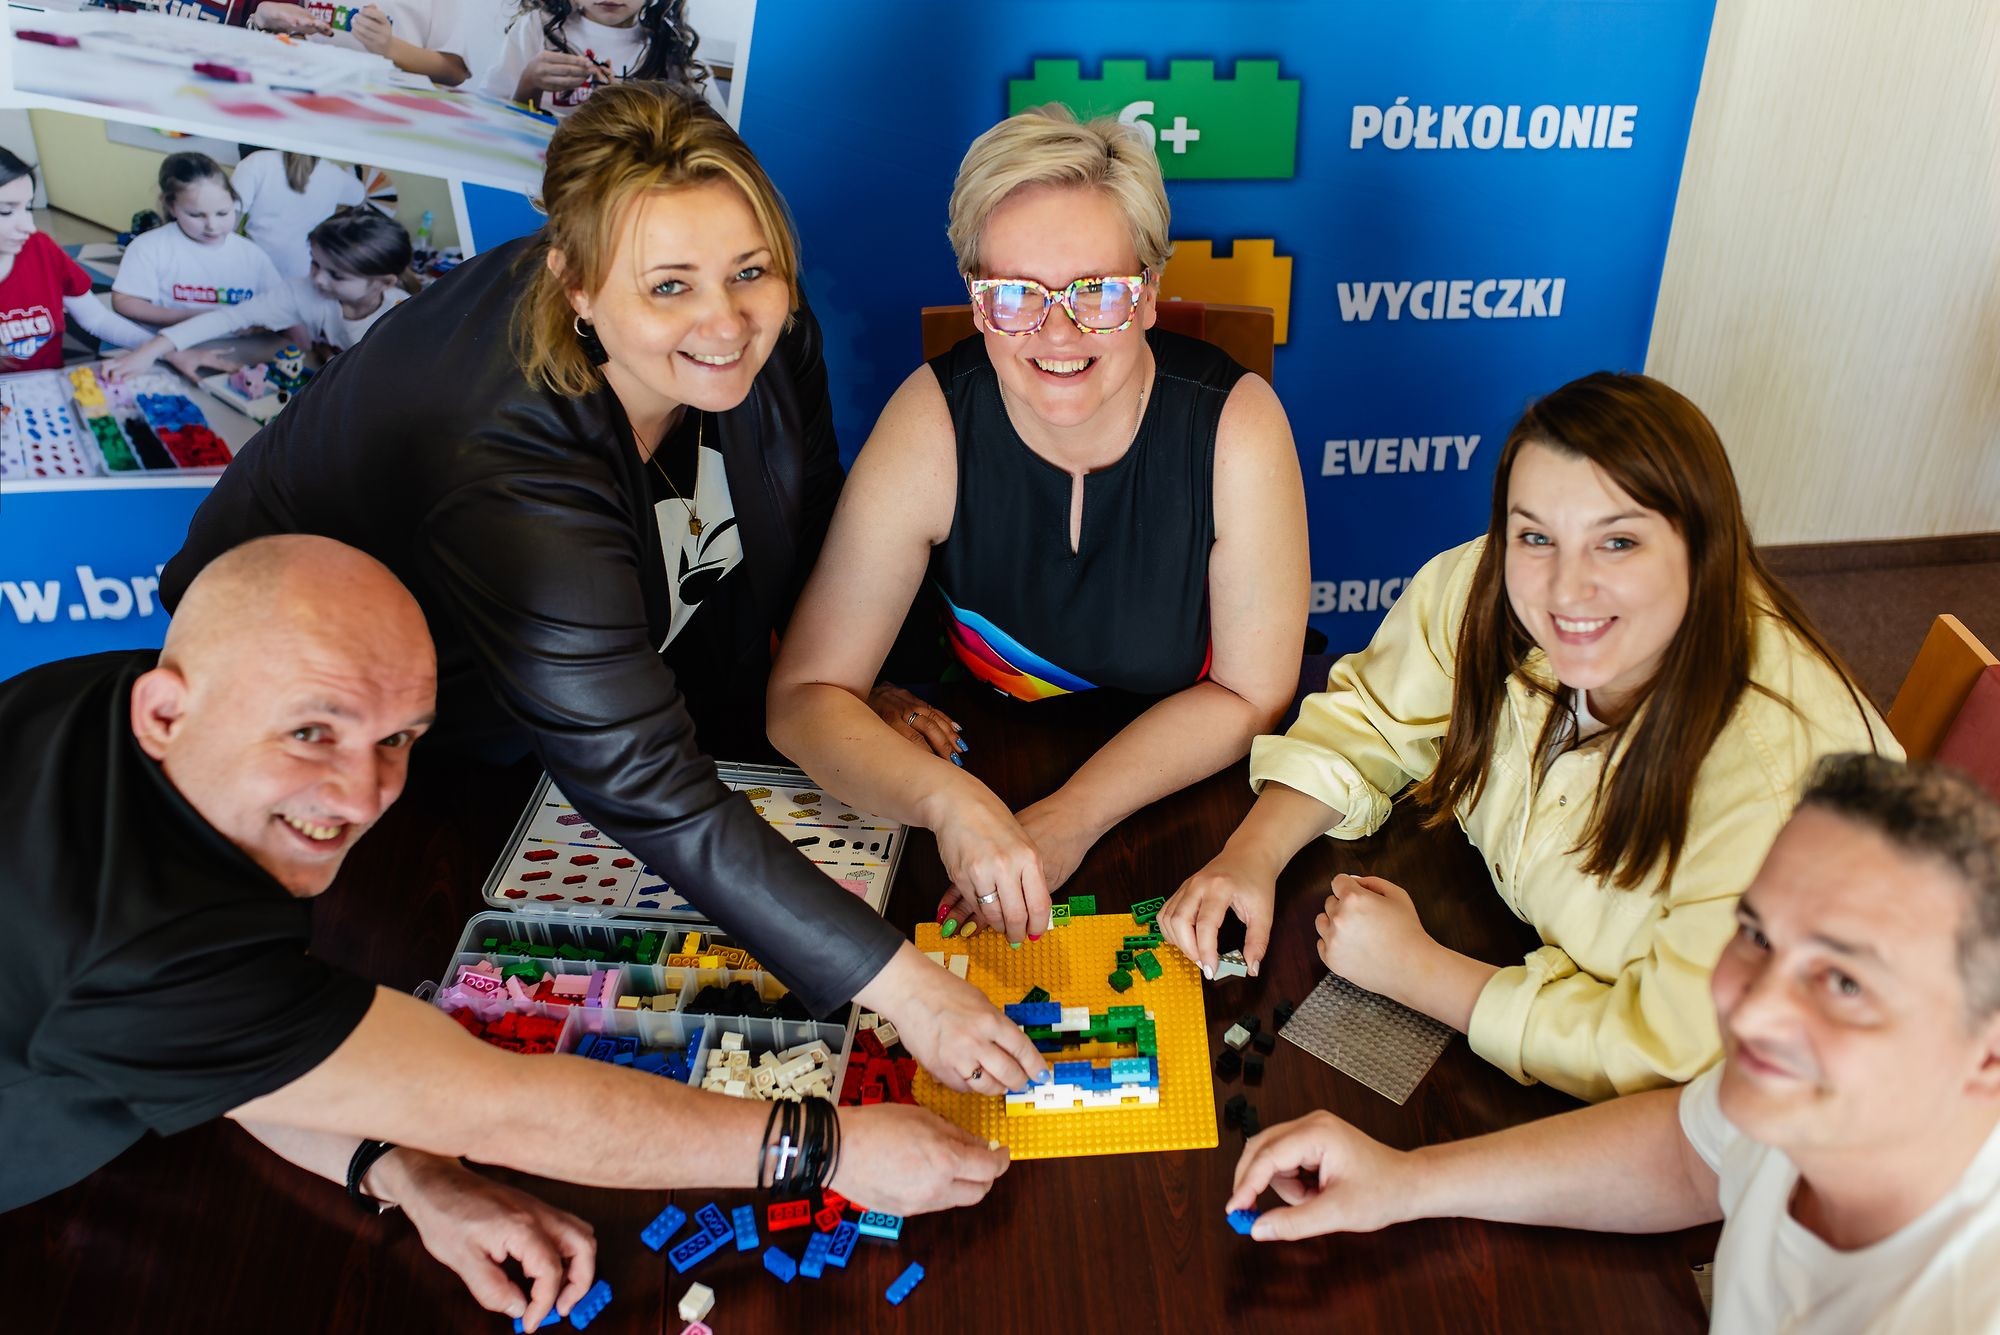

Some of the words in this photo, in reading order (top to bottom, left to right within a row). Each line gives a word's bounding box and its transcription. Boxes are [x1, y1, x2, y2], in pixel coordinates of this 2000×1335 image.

[1118, 100, 1200, 154] 6+
[1350, 96, 1638, 150] PÓŁKOLONIE
[1336, 278, 1566, 322] WYCIECZKI
[1321, 434, 1481, 476] EVENTY
[0, 564, 167, 624] w.br
[1309, 577, 1413, 614] BRIC
